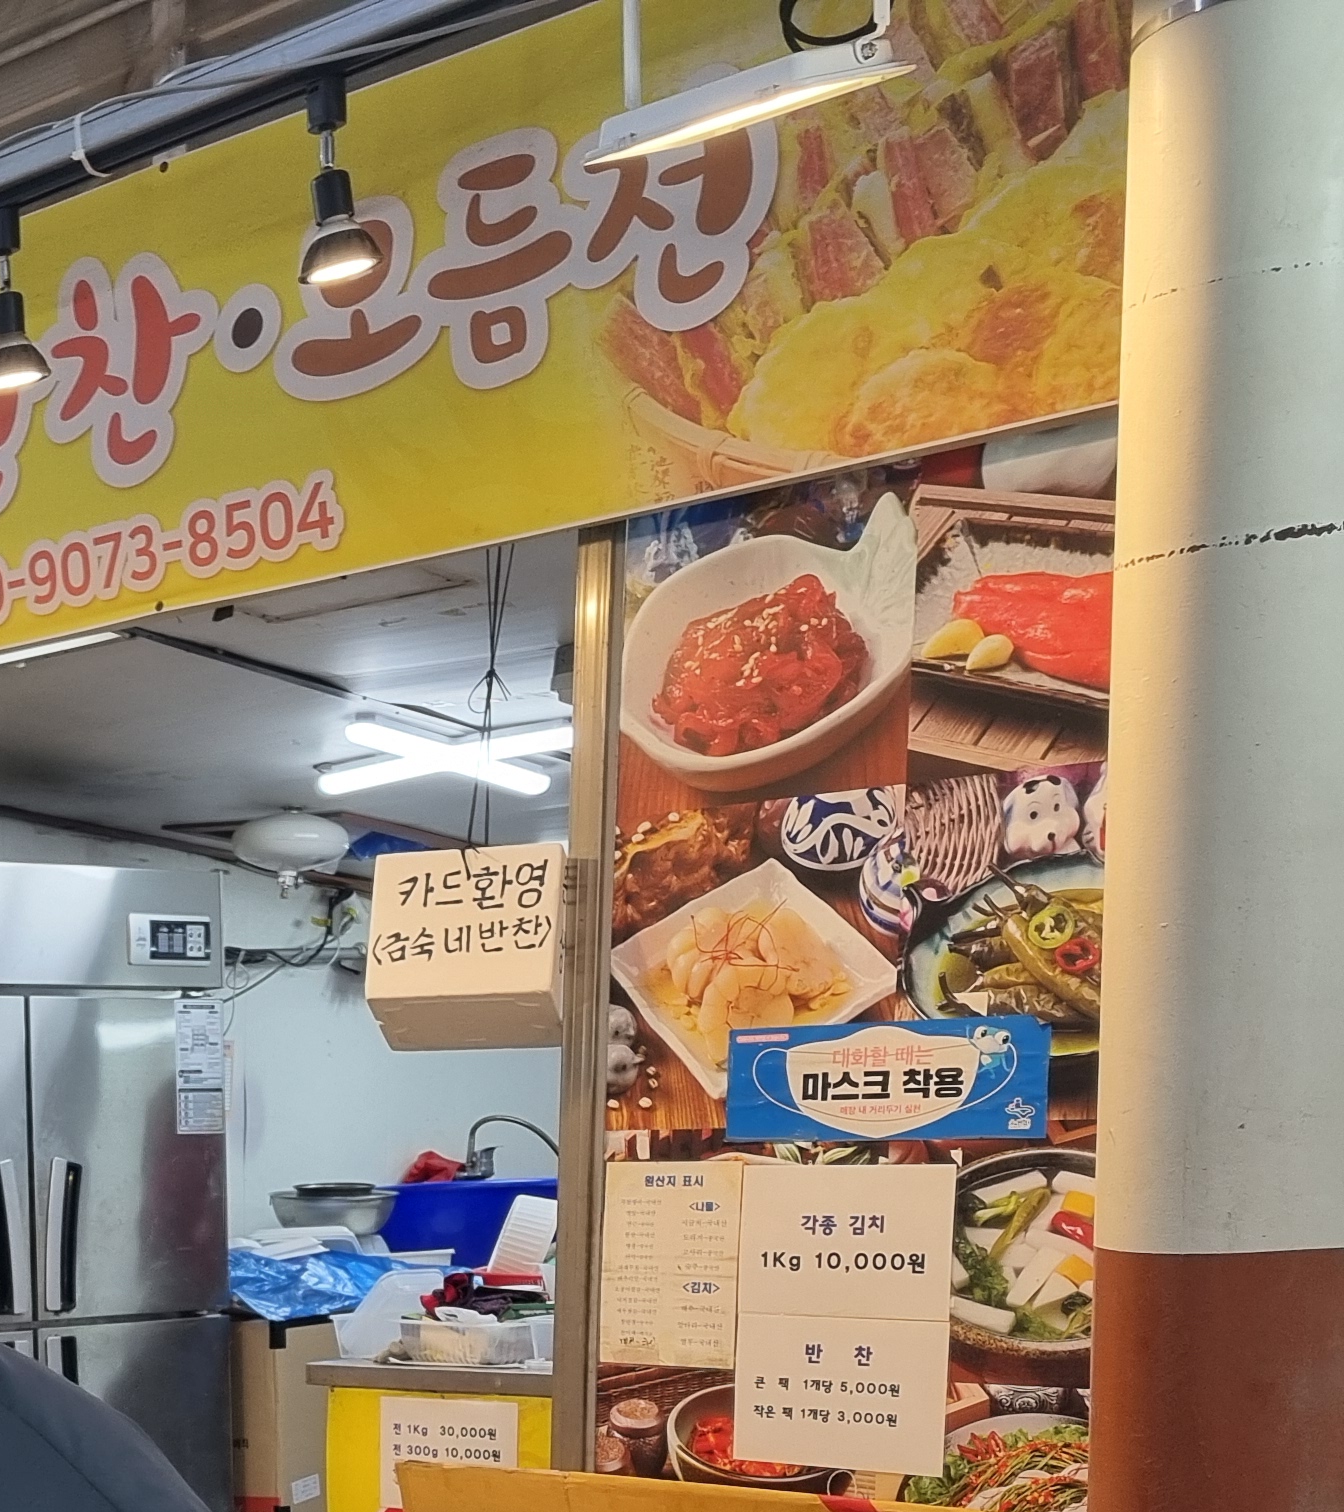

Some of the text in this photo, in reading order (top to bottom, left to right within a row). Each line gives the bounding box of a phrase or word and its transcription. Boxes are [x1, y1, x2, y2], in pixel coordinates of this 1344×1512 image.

[398, 857, 549, 911] 카드환영
[832, 1046, 933, 1068] 대화할 때는
[802, 1067, 964, 1101] 마스크 착용
[644, 1175, 704, 1188] 원산지 표시
[800, 1214, 885, 1237] 각종 김치
[760, 1252, 927, 1275] 1Kg 10,000원
[803, 1378, 833, 1396] 1개당
[840, 1380, 901, 1399] 5,000원
[753, 1405, 776, 1420] 작은
[800, 1407, 831, 1424] 1개당
[837, 1411, 898, 1428] 3,000원
[407, 1424, 428, 1438] 1Kg
[439, 1425, 497, 1441] 30,000원
[407, 1445, 439, 1458] 300g
[444, 1447, 501, 1463] 10,000원
